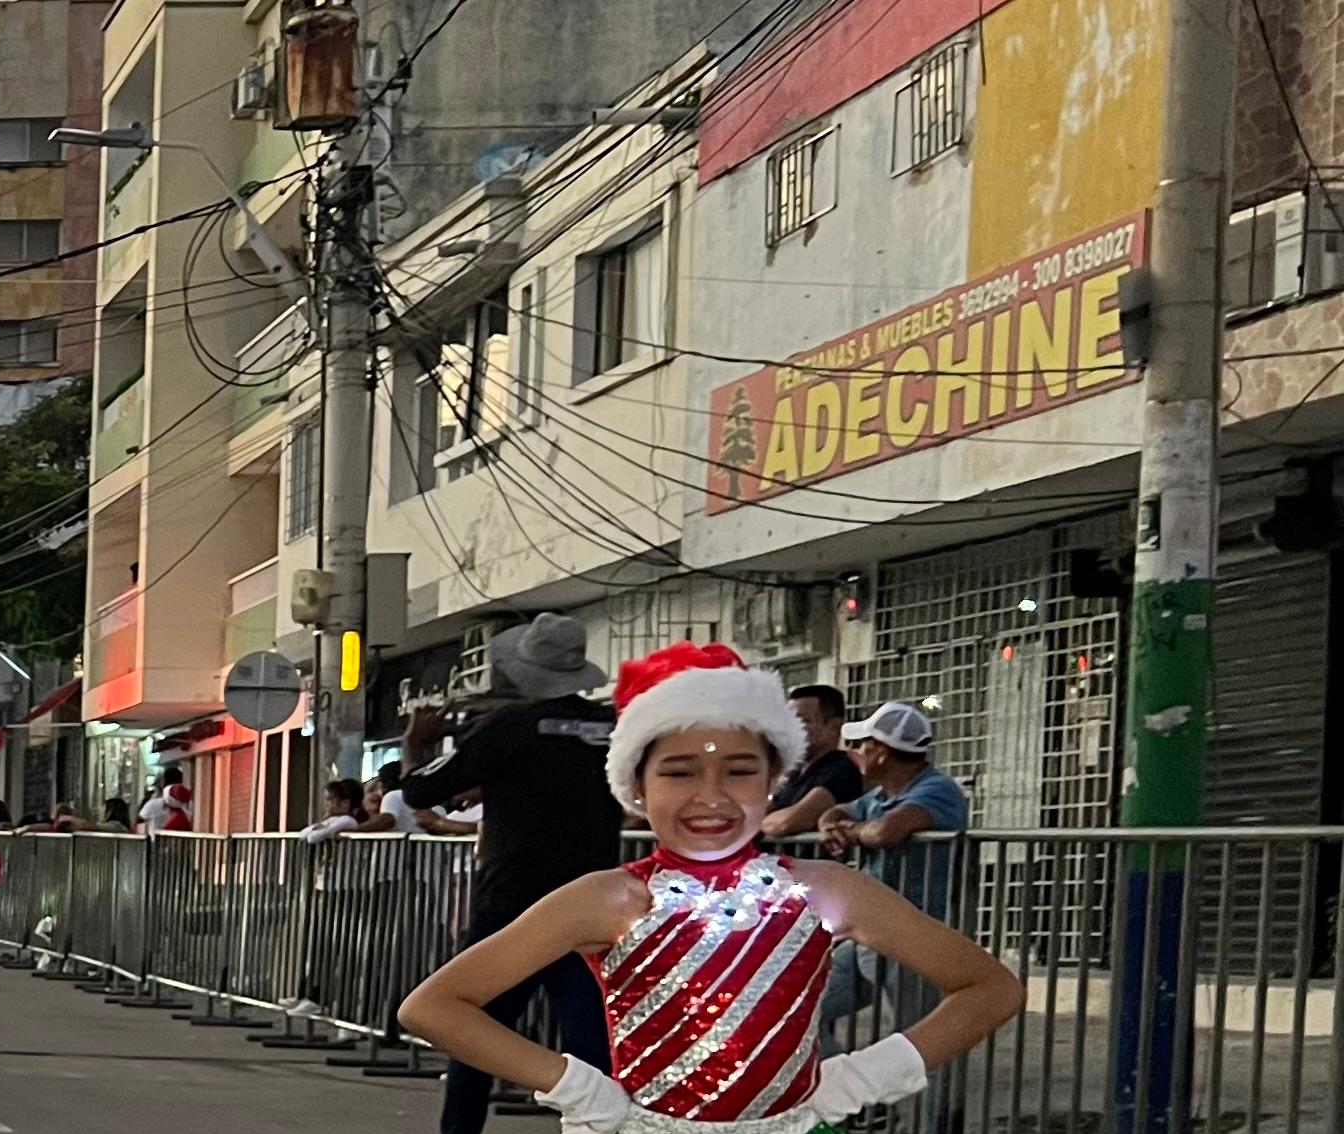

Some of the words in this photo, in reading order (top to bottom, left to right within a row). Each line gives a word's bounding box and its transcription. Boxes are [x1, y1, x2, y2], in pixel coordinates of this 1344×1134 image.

[759, 265, 1132, 490] ADECHINE
[860, 332, 872, 360] &
[876, 297, 954, 351] MUEBLES
[1032, 254, 1061, 290] 300
[1064, 224, 1135, 277] 8398027
